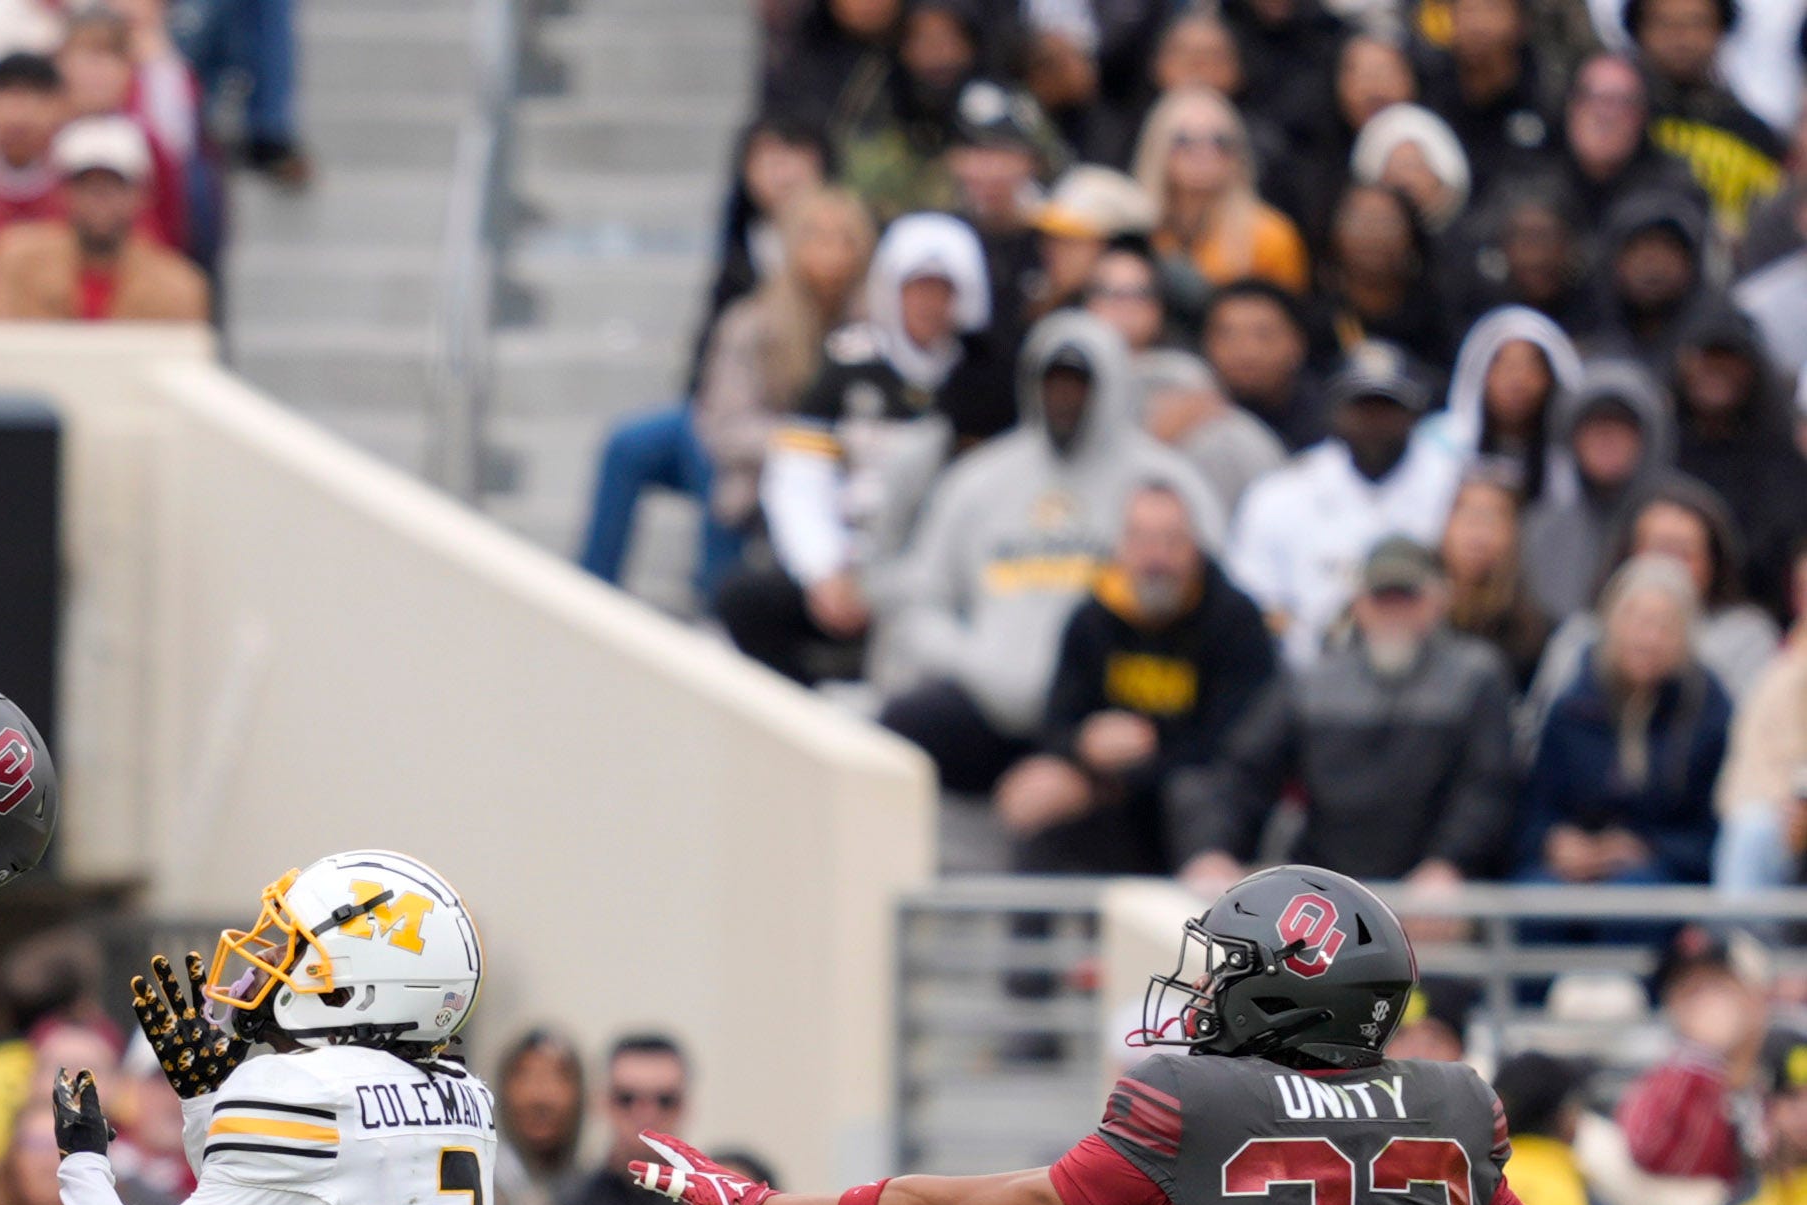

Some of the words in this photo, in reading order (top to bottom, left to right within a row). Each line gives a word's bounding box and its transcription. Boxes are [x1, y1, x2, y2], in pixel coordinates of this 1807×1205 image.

[338, 879, 434, 956] M
[355, 1080, 483, 1130] COLEMAN
[1274, 1074, 1408, 1120] UNITY
